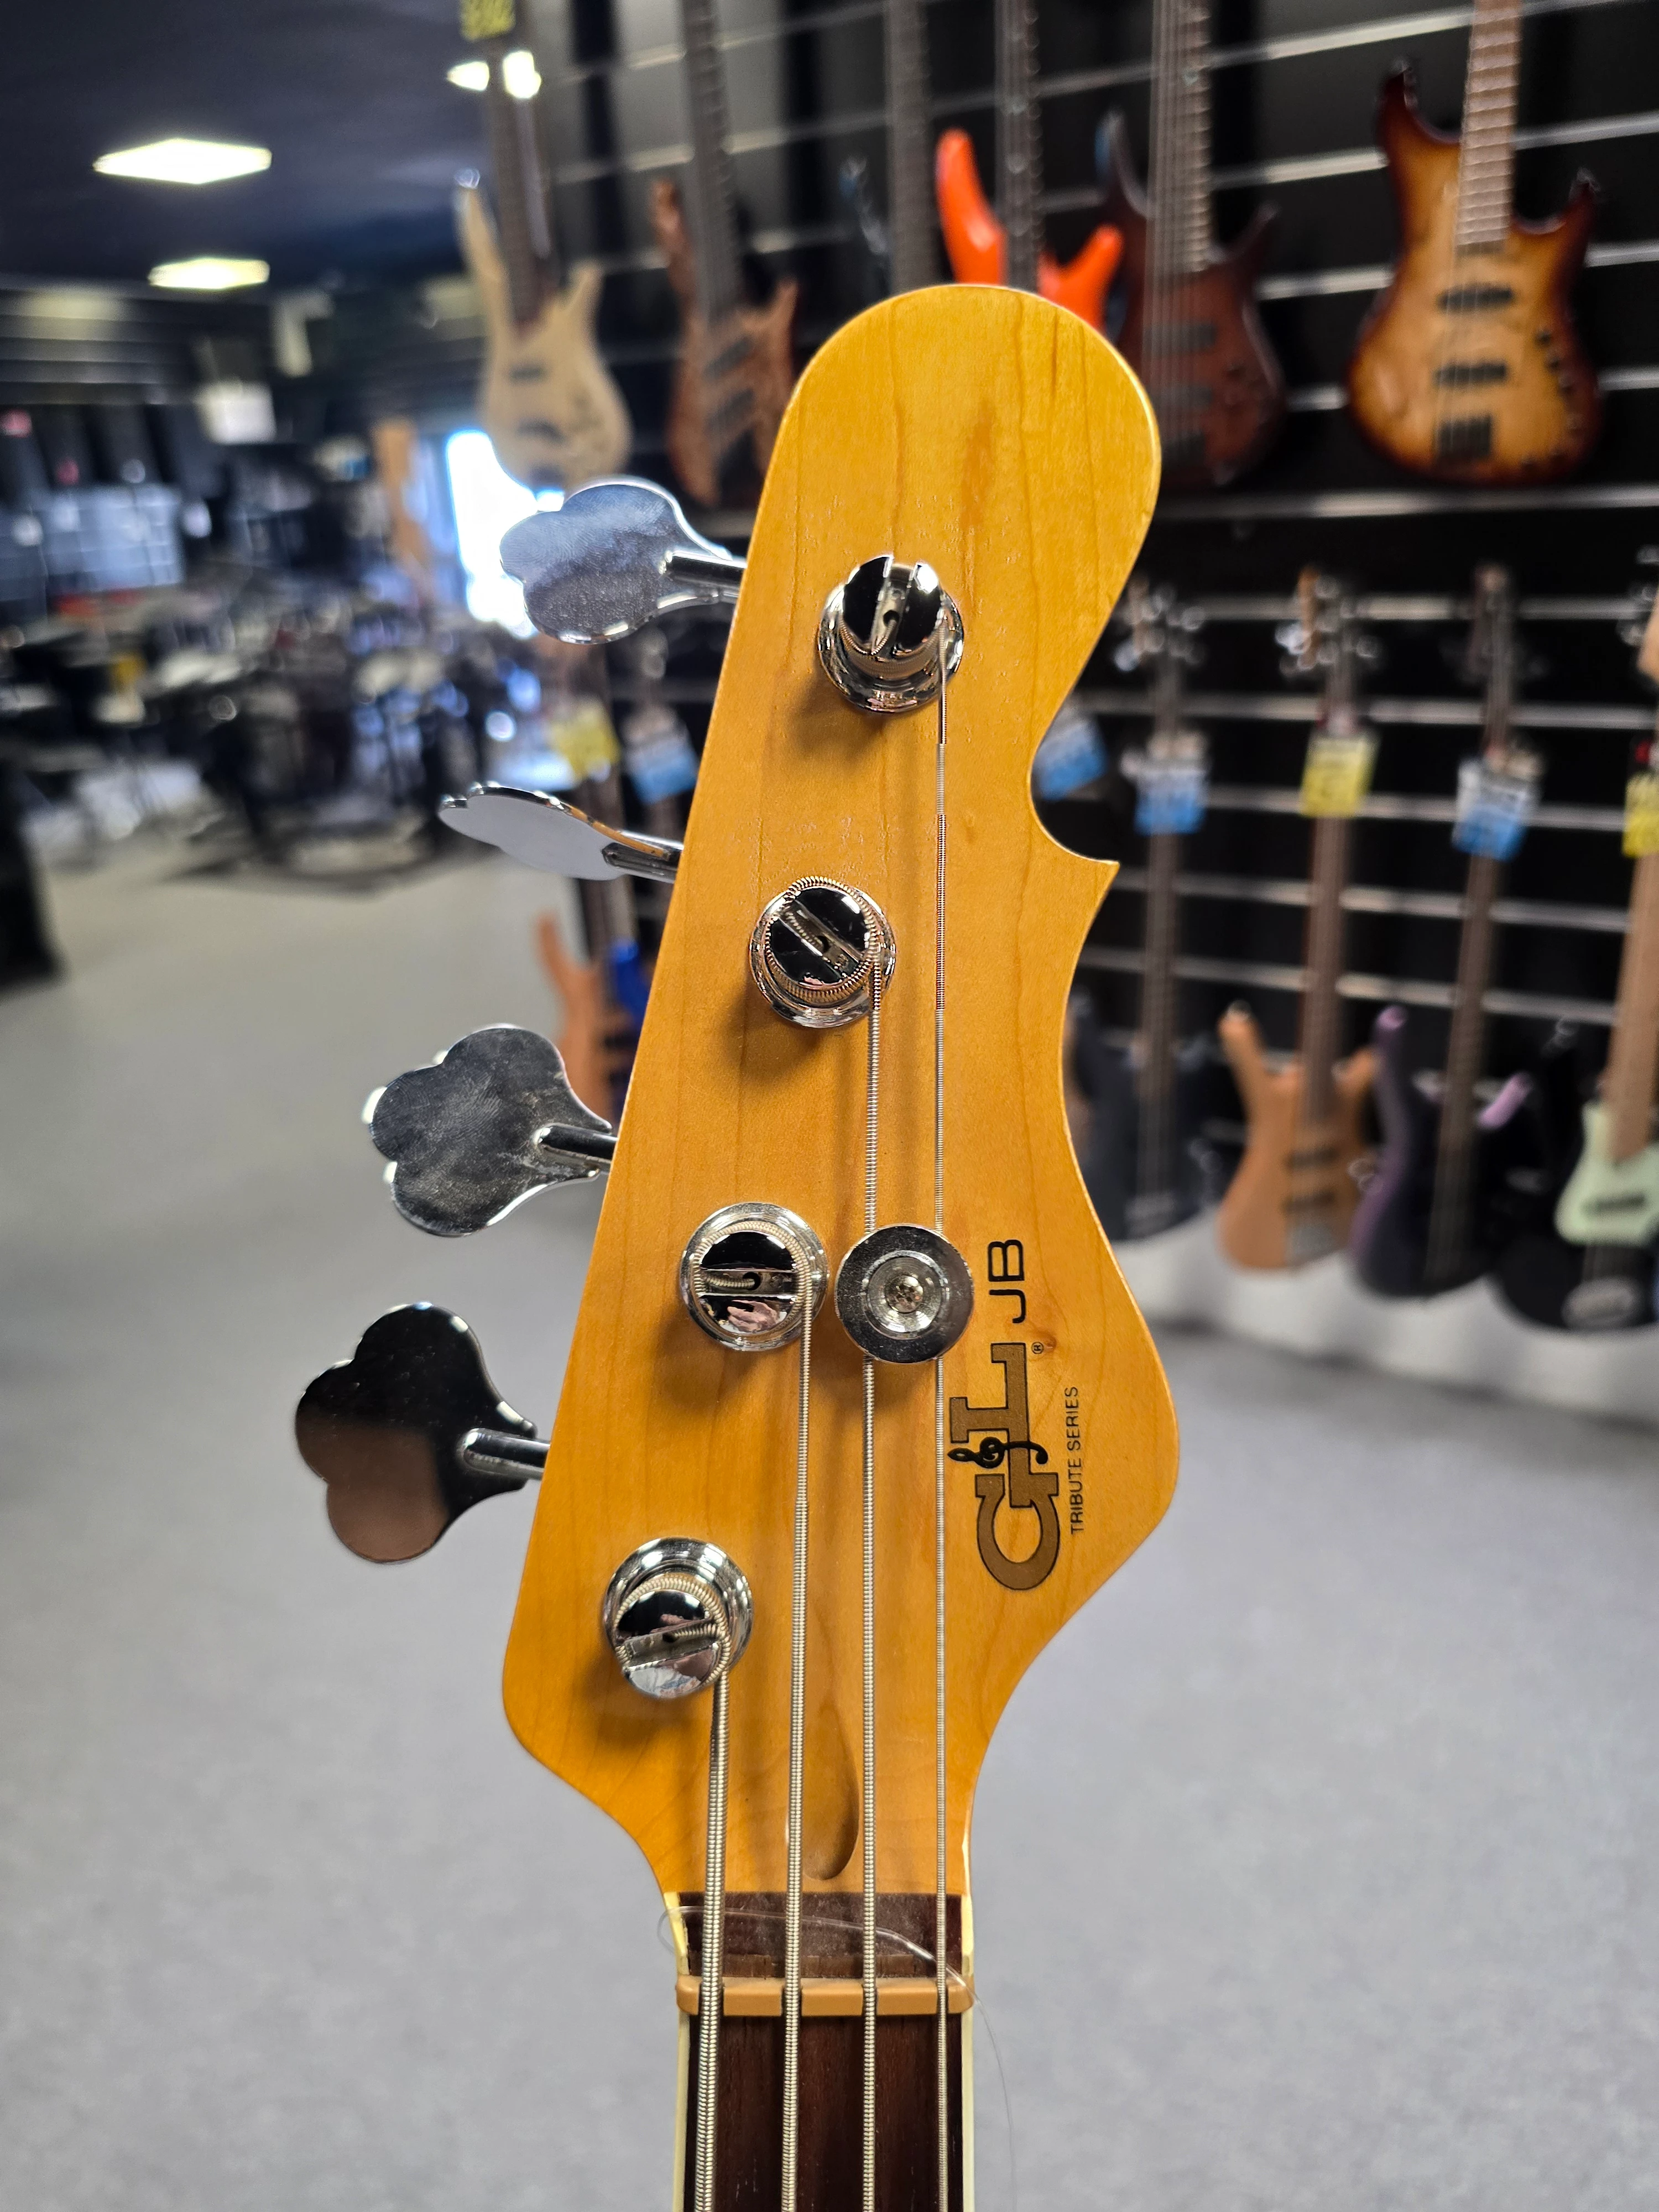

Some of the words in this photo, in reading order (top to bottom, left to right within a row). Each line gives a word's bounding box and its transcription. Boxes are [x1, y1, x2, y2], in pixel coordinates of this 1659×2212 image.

[987, 1239, 1026, 1324] JB
[1065, 1386, 1081, 1451] SERIES
[1067, 1458, 1084, 1535] TRIBUTE
